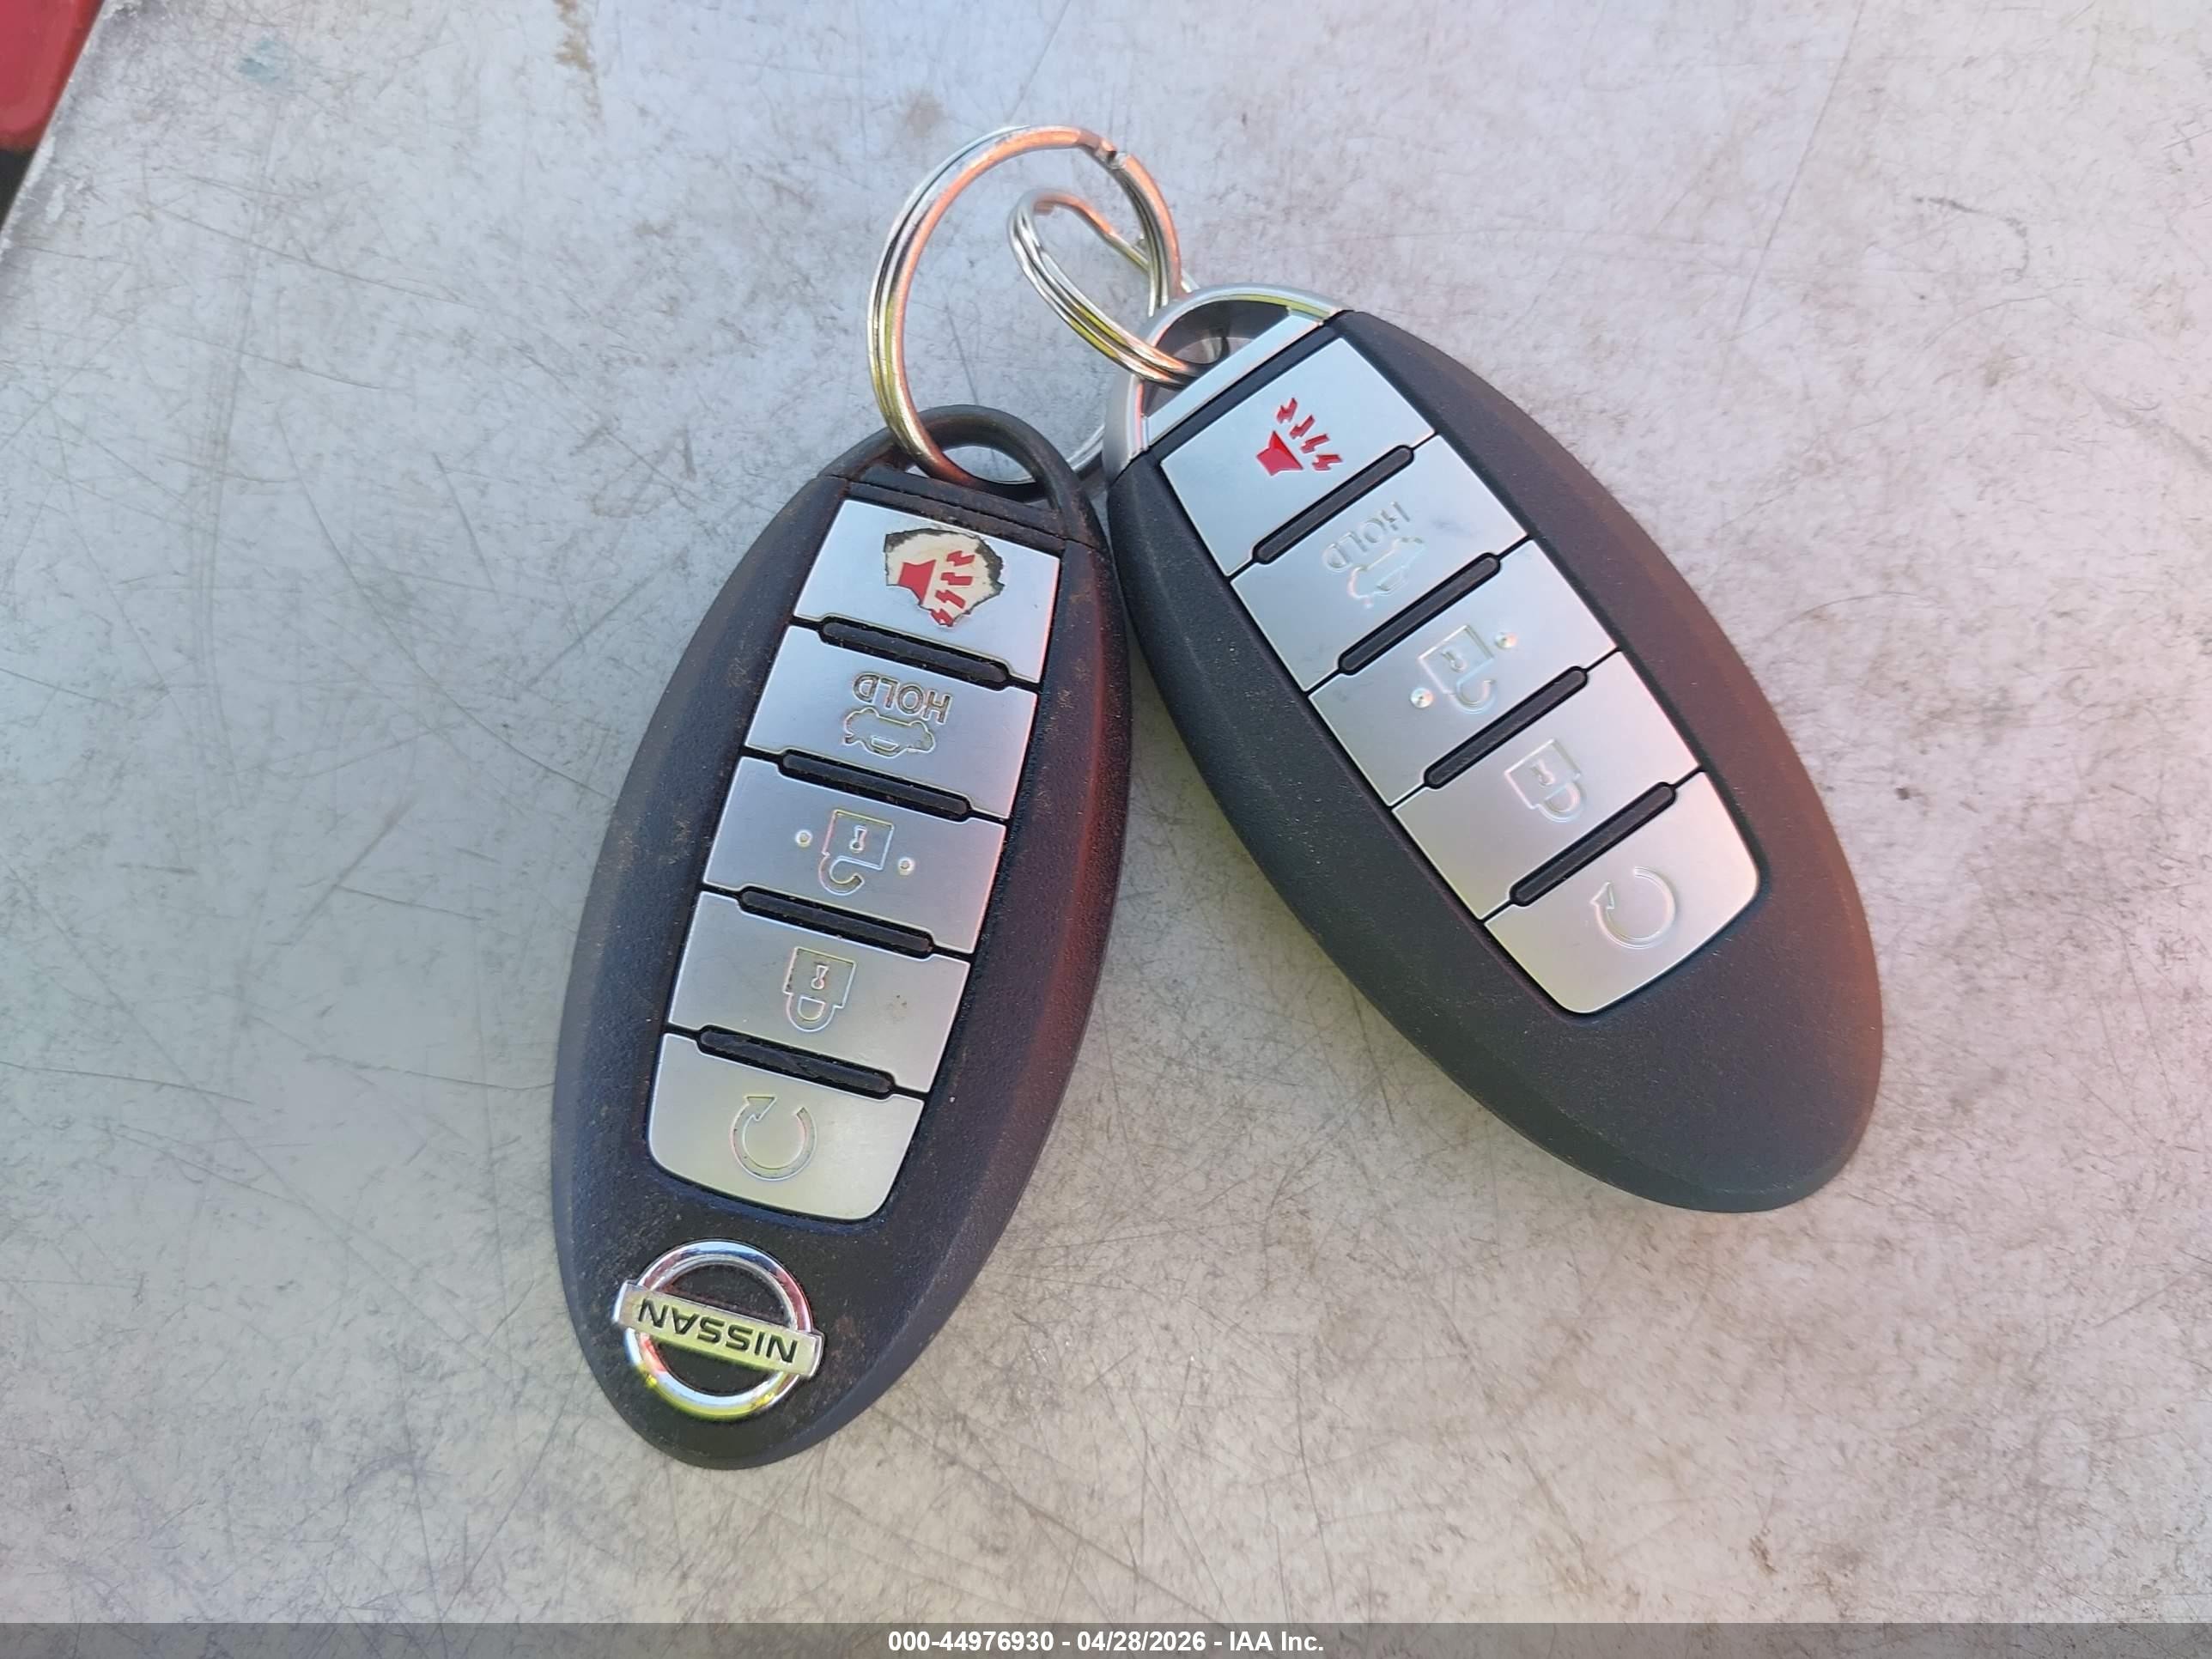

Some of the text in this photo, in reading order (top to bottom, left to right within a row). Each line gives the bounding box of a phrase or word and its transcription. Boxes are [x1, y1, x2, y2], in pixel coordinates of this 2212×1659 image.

[1322, 501, 1411, 572] HOLD
[853, 673, 951, 724] HOLD
[638, 1297, 798, 1364] NISSAN
